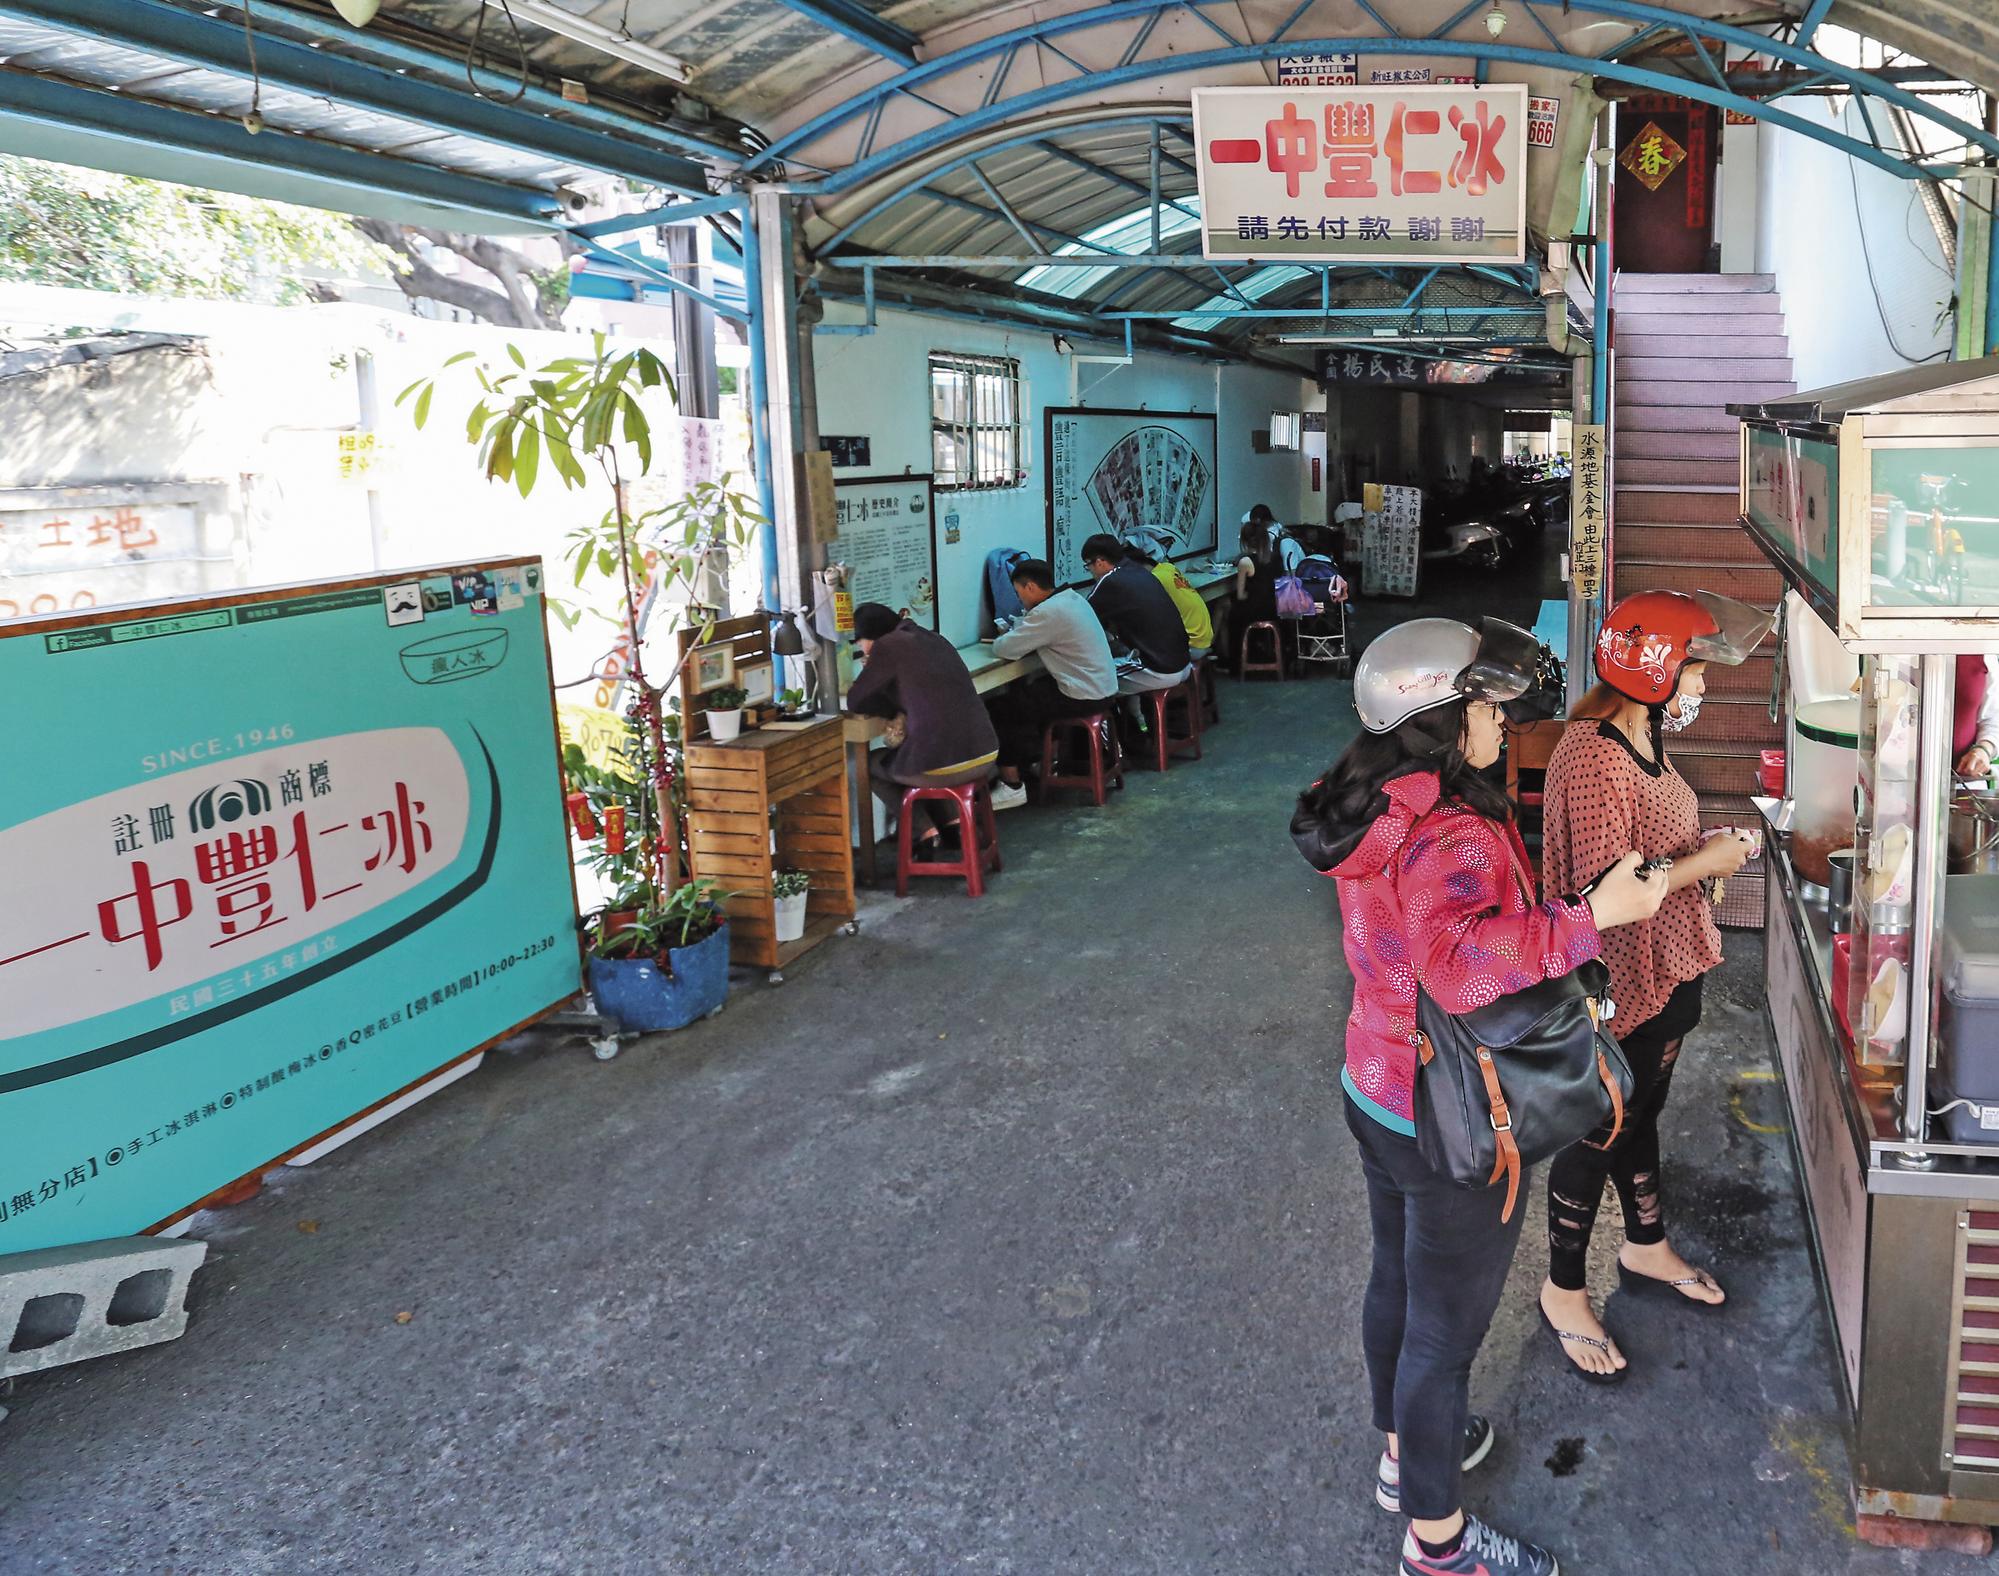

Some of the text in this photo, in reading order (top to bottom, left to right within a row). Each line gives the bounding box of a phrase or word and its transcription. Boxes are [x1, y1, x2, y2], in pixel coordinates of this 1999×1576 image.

[1370, 68, 1431, 82] 新旺搬家公司
[1209, 100, 1507, 198] 一中豐仁冰
[1528, 120, 1554, 144] 666
[1638, 135, 1672, 175] 春
[1237, 215, 1485, 242] 請先付款 謝謝
[1579, 431, 1602, 521] 水源地基金會
[141, 723, 295, 774] SINCE.1946
[111, 760, 333, 856] 註冊 商標
[0, 781, 432, 972] 一中豐仁冰
